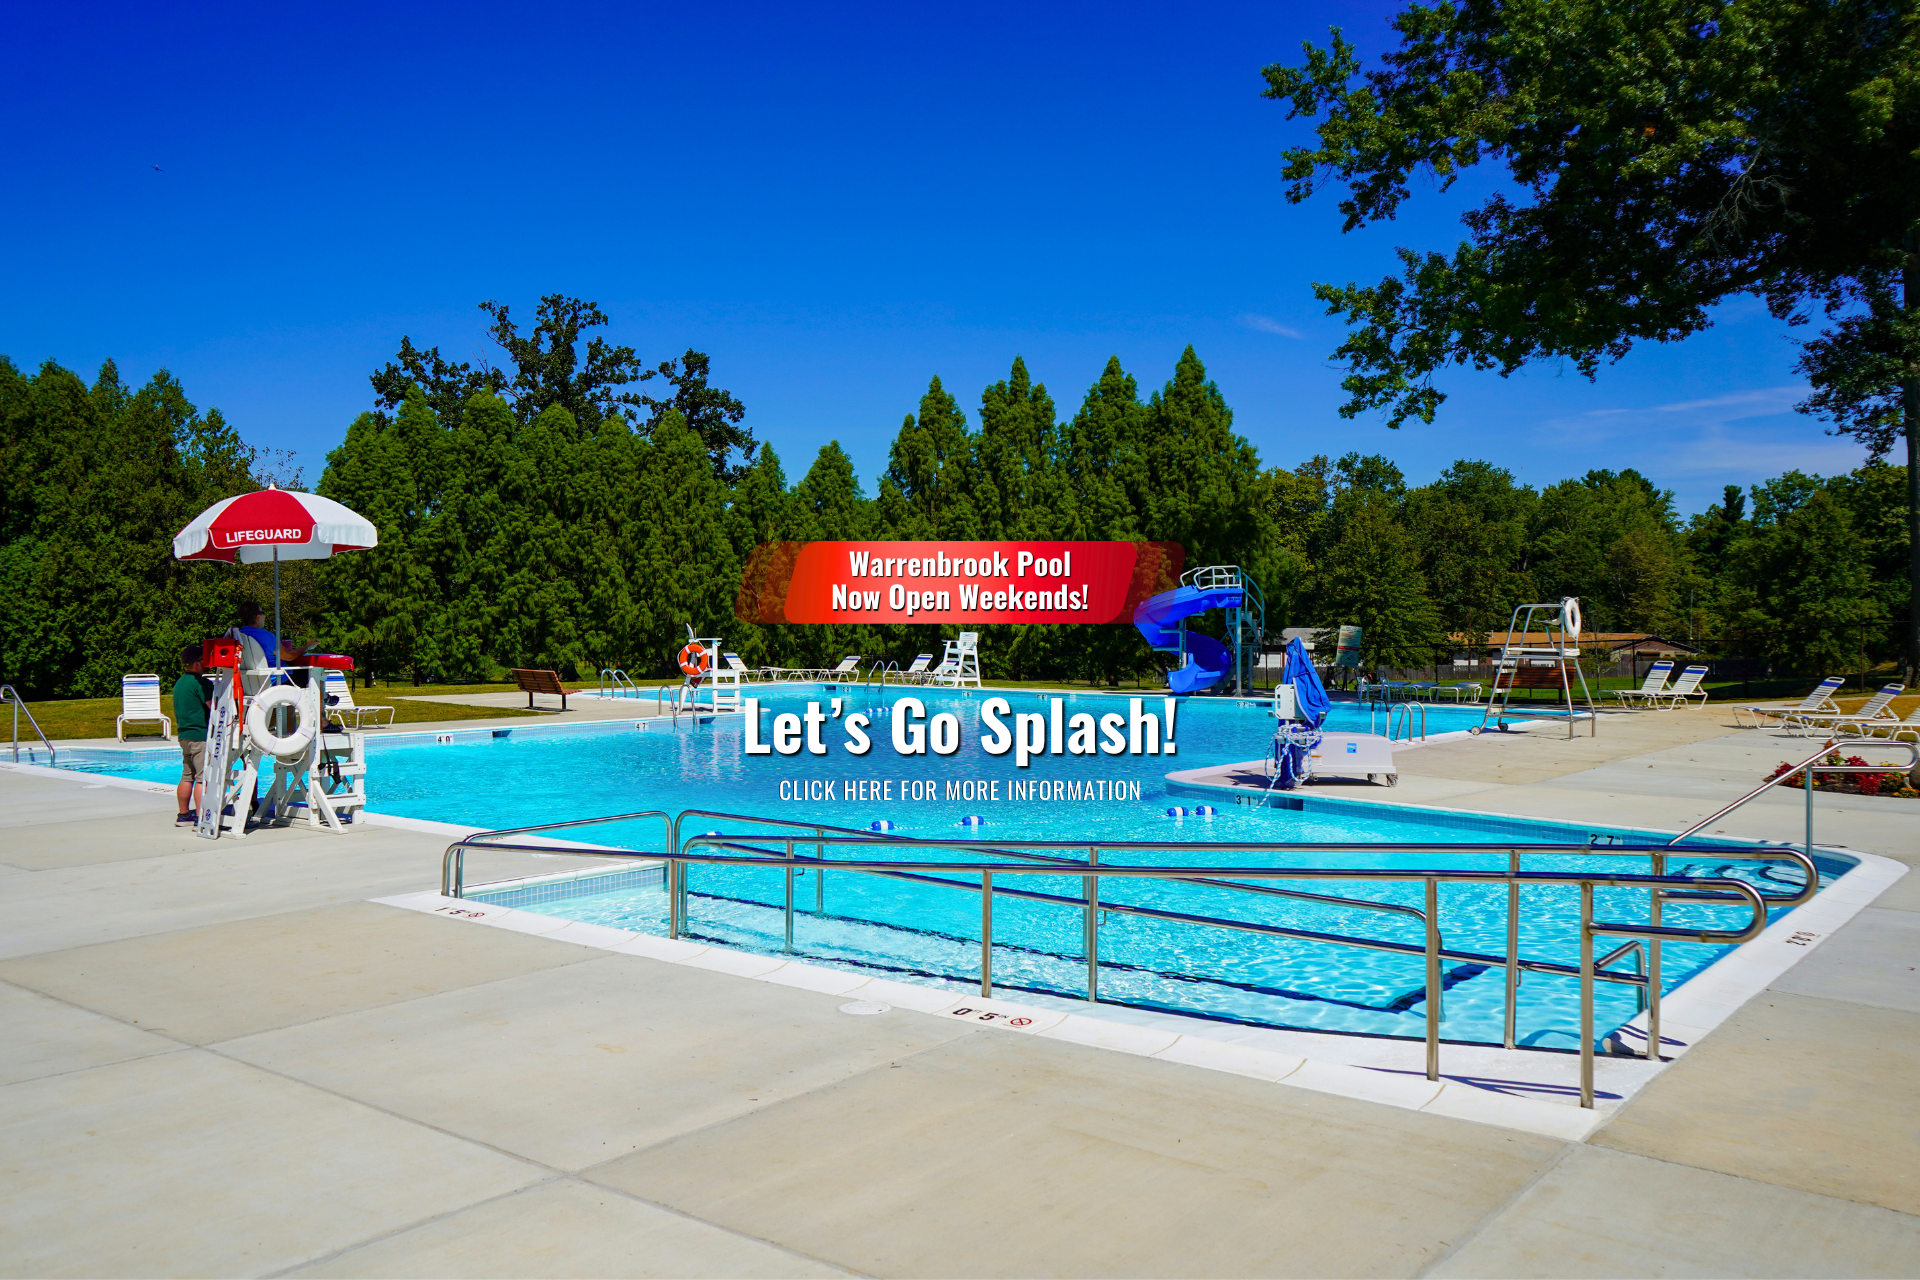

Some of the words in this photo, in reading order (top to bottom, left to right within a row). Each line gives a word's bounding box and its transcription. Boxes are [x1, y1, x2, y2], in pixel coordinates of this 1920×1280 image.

[225, 528, 302, 543] LIFEGUARD
[213, 720, 224, 760] Kiefer
[1236, 794, 1242, 805] 3
[1590, 834, 1598, 845] 2
[1606, 835, 1614, 845] 7
[979, 1012, 1000, 1020] 5
